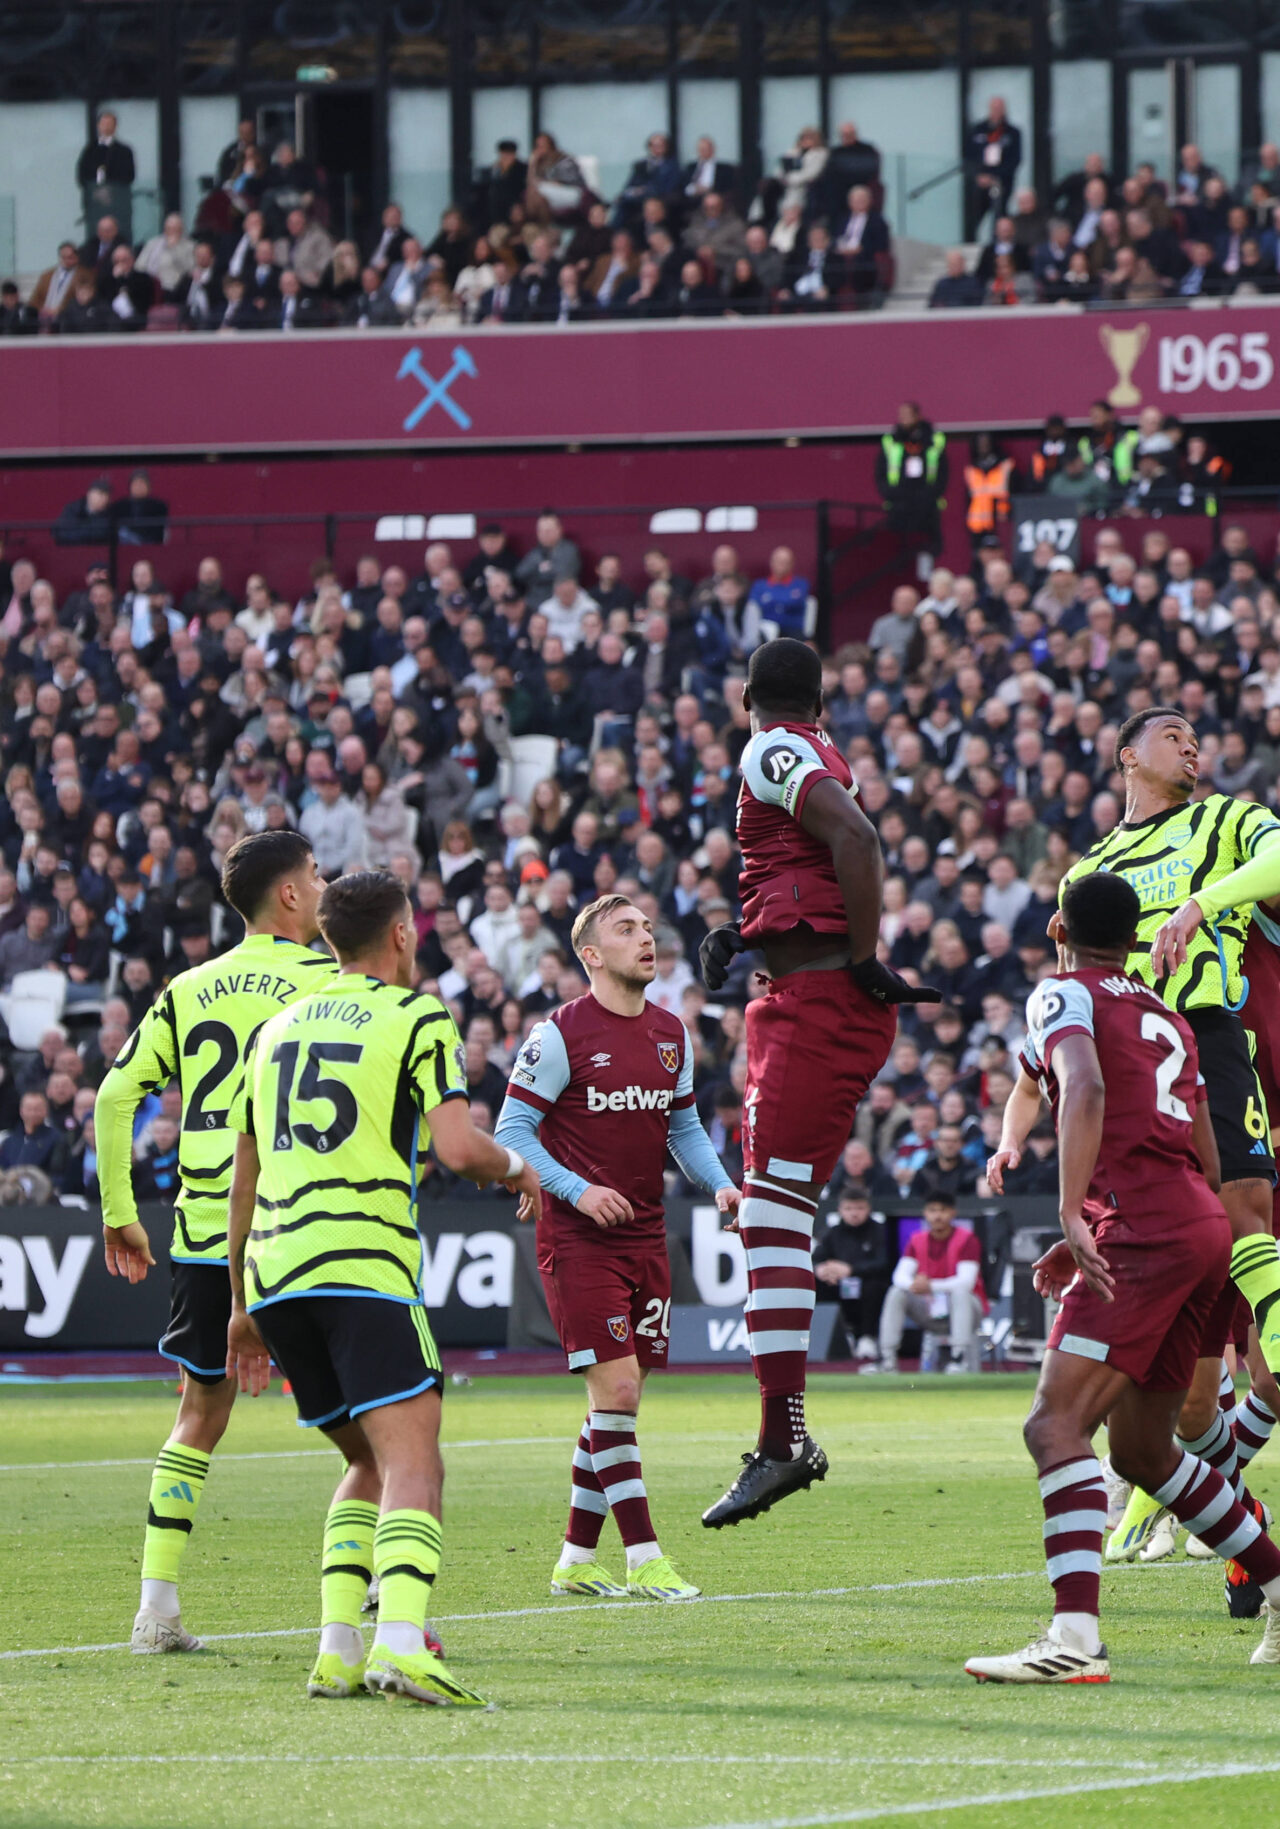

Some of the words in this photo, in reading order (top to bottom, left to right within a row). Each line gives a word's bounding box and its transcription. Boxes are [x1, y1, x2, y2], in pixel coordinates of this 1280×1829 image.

[1158, 331, 1274, 394] 1965
[1017, 518, 1078, 553] 107
[769, 750, 797, 782] JD
[197, 973, 298, 1010] HAVERTZ
[1140, 1011, 1194, 1123] 2
[270, 1039, 364, 1155] 15
[1243, 1095, 1266, 1140] 6
